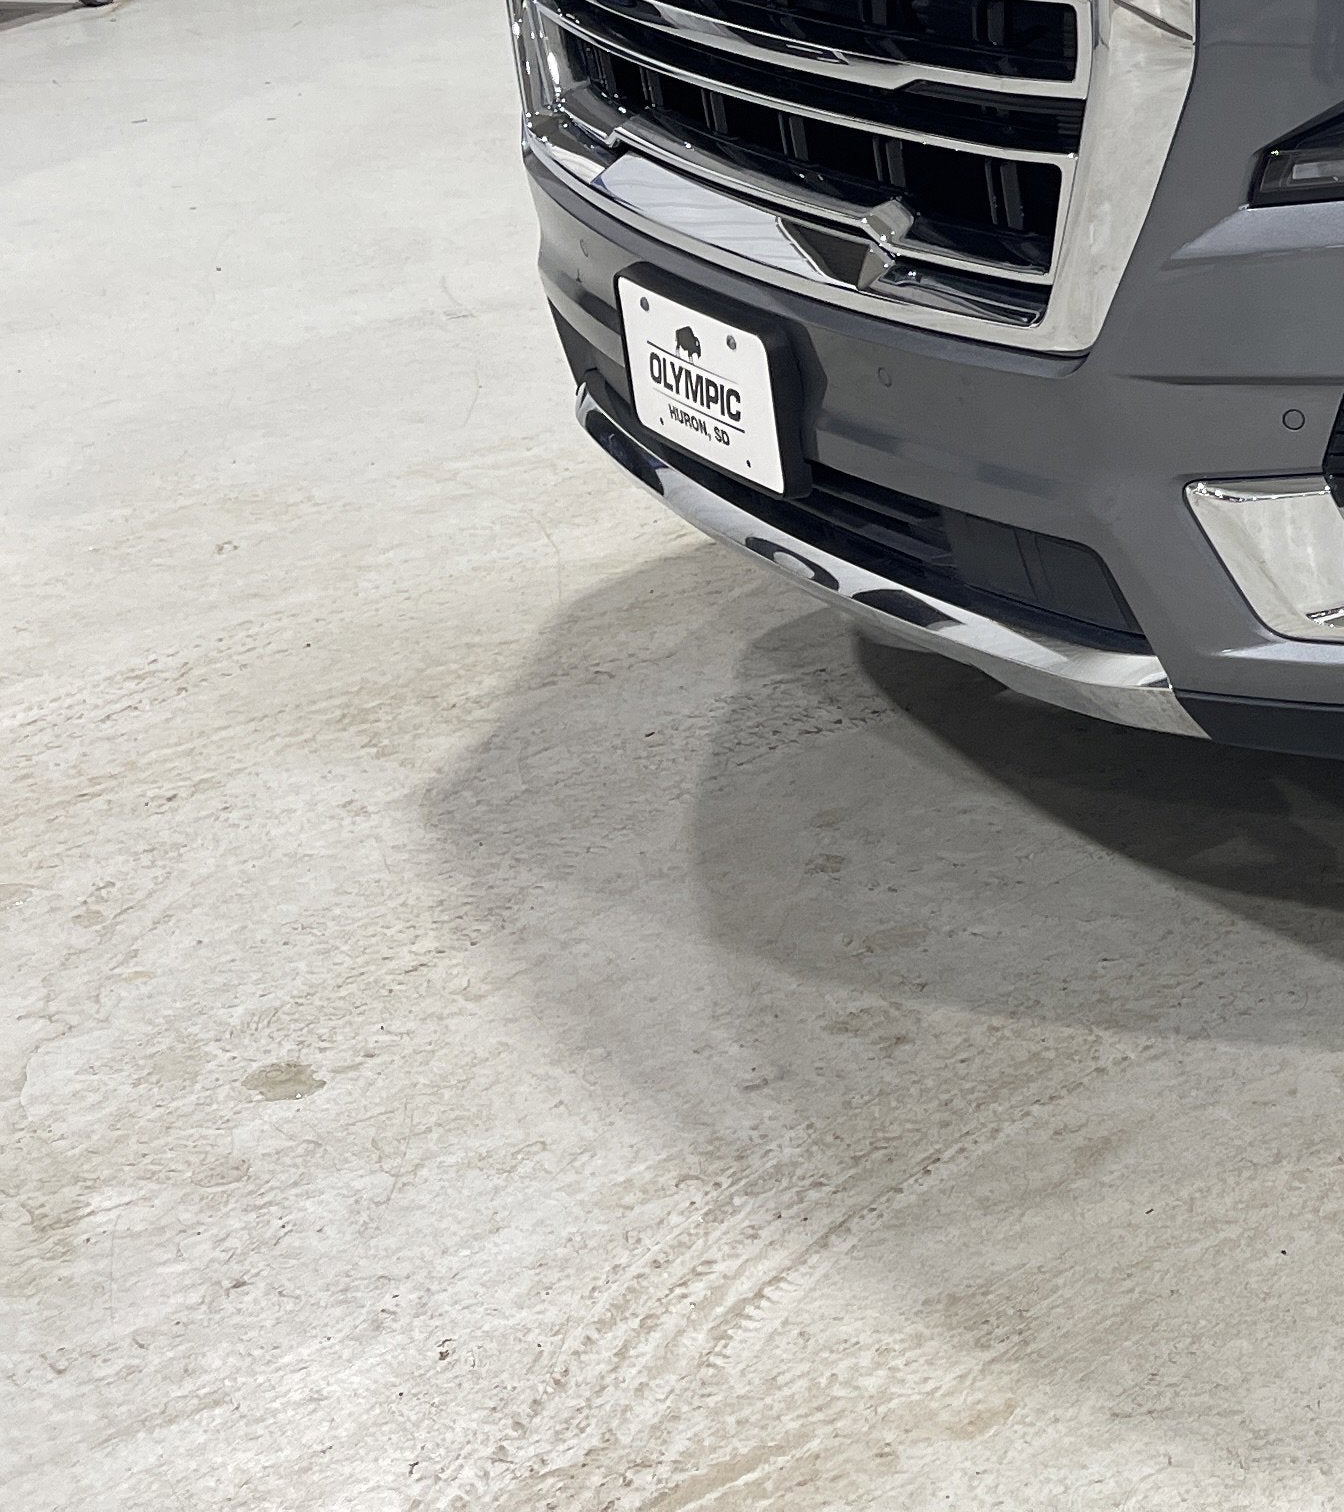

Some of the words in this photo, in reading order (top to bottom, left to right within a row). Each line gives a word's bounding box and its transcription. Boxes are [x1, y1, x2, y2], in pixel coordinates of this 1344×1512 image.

[650, 352, 741, 423] OLYMPIC
[668, 403, 712, 442] HURON,
[714, 426, 730, 446] SD
